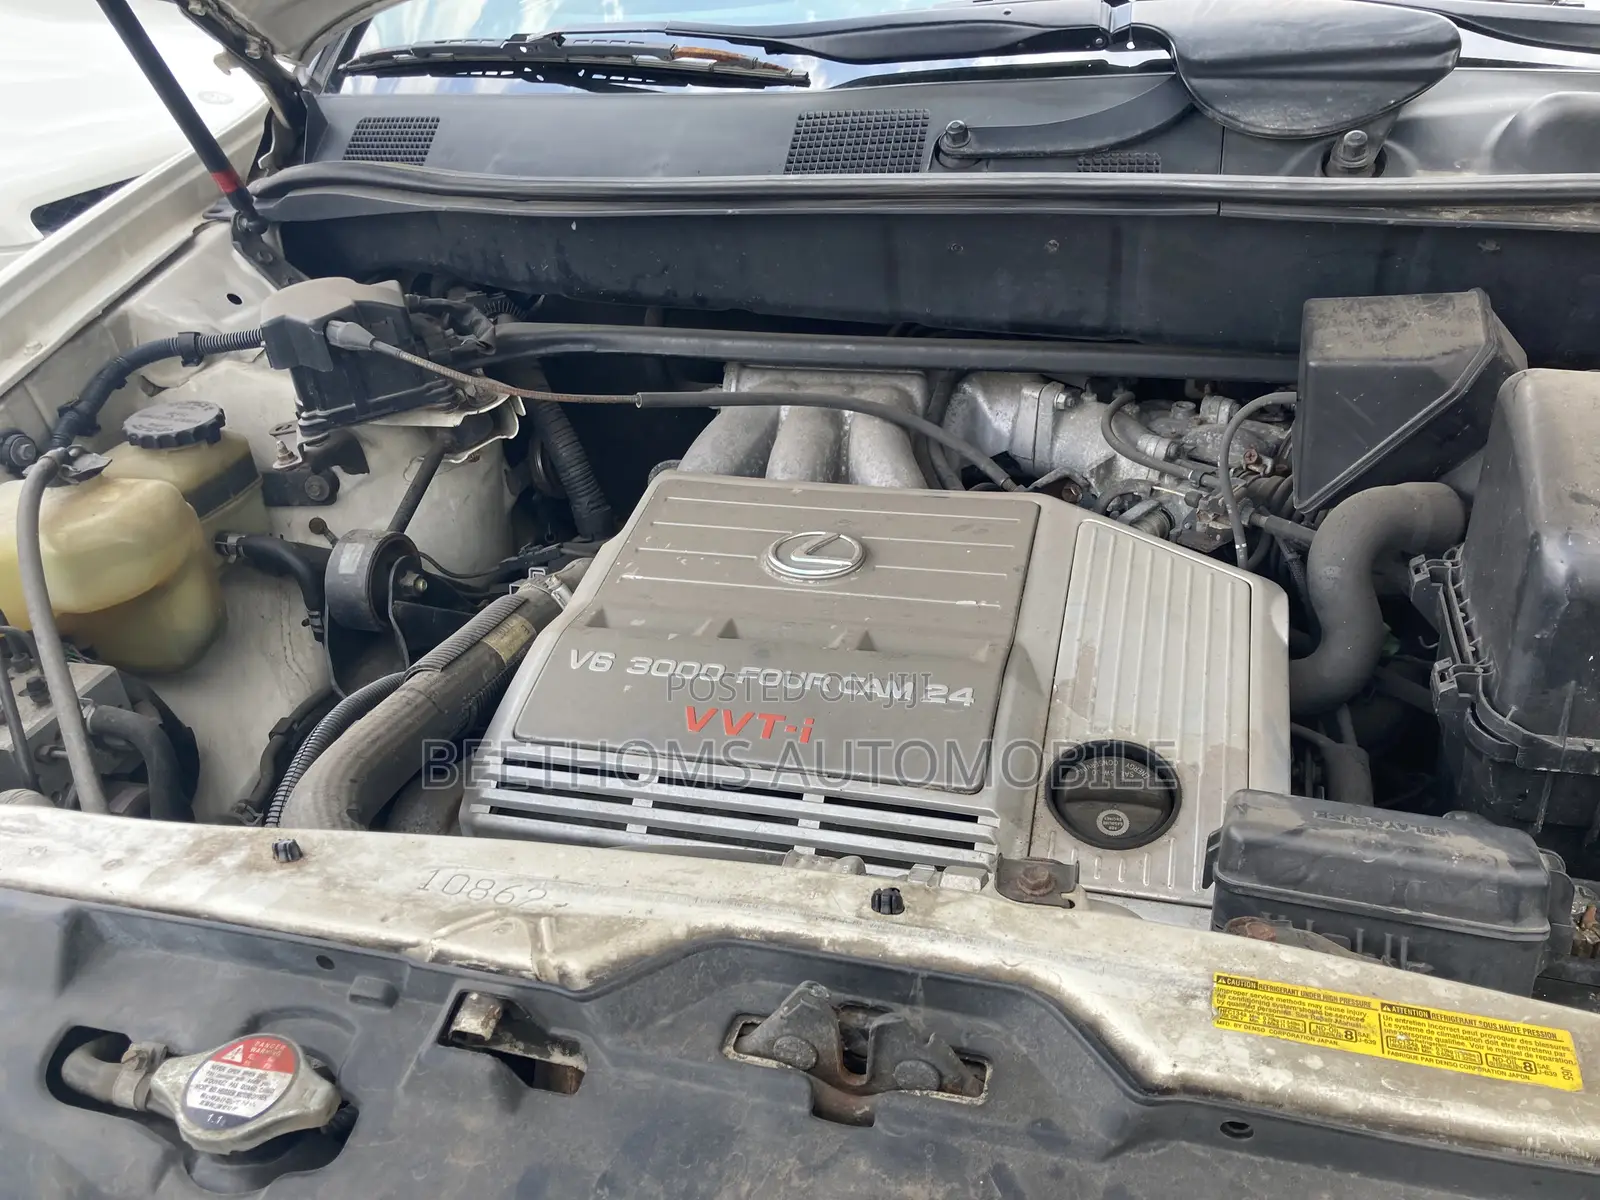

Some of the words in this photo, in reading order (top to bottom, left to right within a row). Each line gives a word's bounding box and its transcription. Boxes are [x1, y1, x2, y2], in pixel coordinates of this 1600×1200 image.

[569, 649, 617, 672] V6
[625, 656, 726, 682] 3000
[735, 666, 832, 693] FOUR
[838, 676, 915, 701] CAM
[920, 683, 976, 707] 24
[685, 705, 816, 744] VVT-i
[1124, 762, 1150, 779] ENERGY
[1217, 987, 1248, 998] Improper
[1249, 992, 1274, 1001] service
[1275, 996, 1306, 1006] methods
[1307, 1002, 1323, 1010] may
[1324, 1005, 1345, 1013] cause
[1227, 979, 1257, 989] CAUTION
[1258, 984, 1300, 996] REFRIGERANT
[1300, 990, 1321, 999] UNDER
[1339, 997, 1372, 1008] PRESSURE
[1228, 994, 1271, 1007] conditioning
[1226, 1001, 1255, 1010] qualified
[1243, 1025, 1266, 1033] DENSO
[1268, 1028, 1316, 1042] CORPORATION
[1391, 1006, 1429, 1018] ATTENTION
[1499, 1024, 1521, 1033] HAUTE
[1522, 1027, 1557, 1039] PRESSION
[1394, 1018, 1426, 1027] entretien
[1427, 1022, 1460, 1033] incorrect
[1462, 1029, 1478, 1037] peut
[1480, 1032, 1518, 1043] provoquer
[254, 1040, 286, 1051] DANGER
[1344, 1030, 1355, 1040] 8
[1398, 1030, 1433, 1040] personne
[1469, 1042, 1484, 1050] Voir
[1495, 1047, 1523, 1056] manuel
[1436, 1030, 1484, 1043] climatisation
[1485, 1039, 1499, 1047] doit
[1517, 1044, 1552, 1055] entretenu
[1553, 1050, 1566, 1058] par
[1420, 1055, 1435, 1063] PAR
[1435, 1058, 1458, 1068] DENSO
[1459, 1062, 1507, 1076] CORPORATION
[1523, 1061, 1534, 1072] 8
